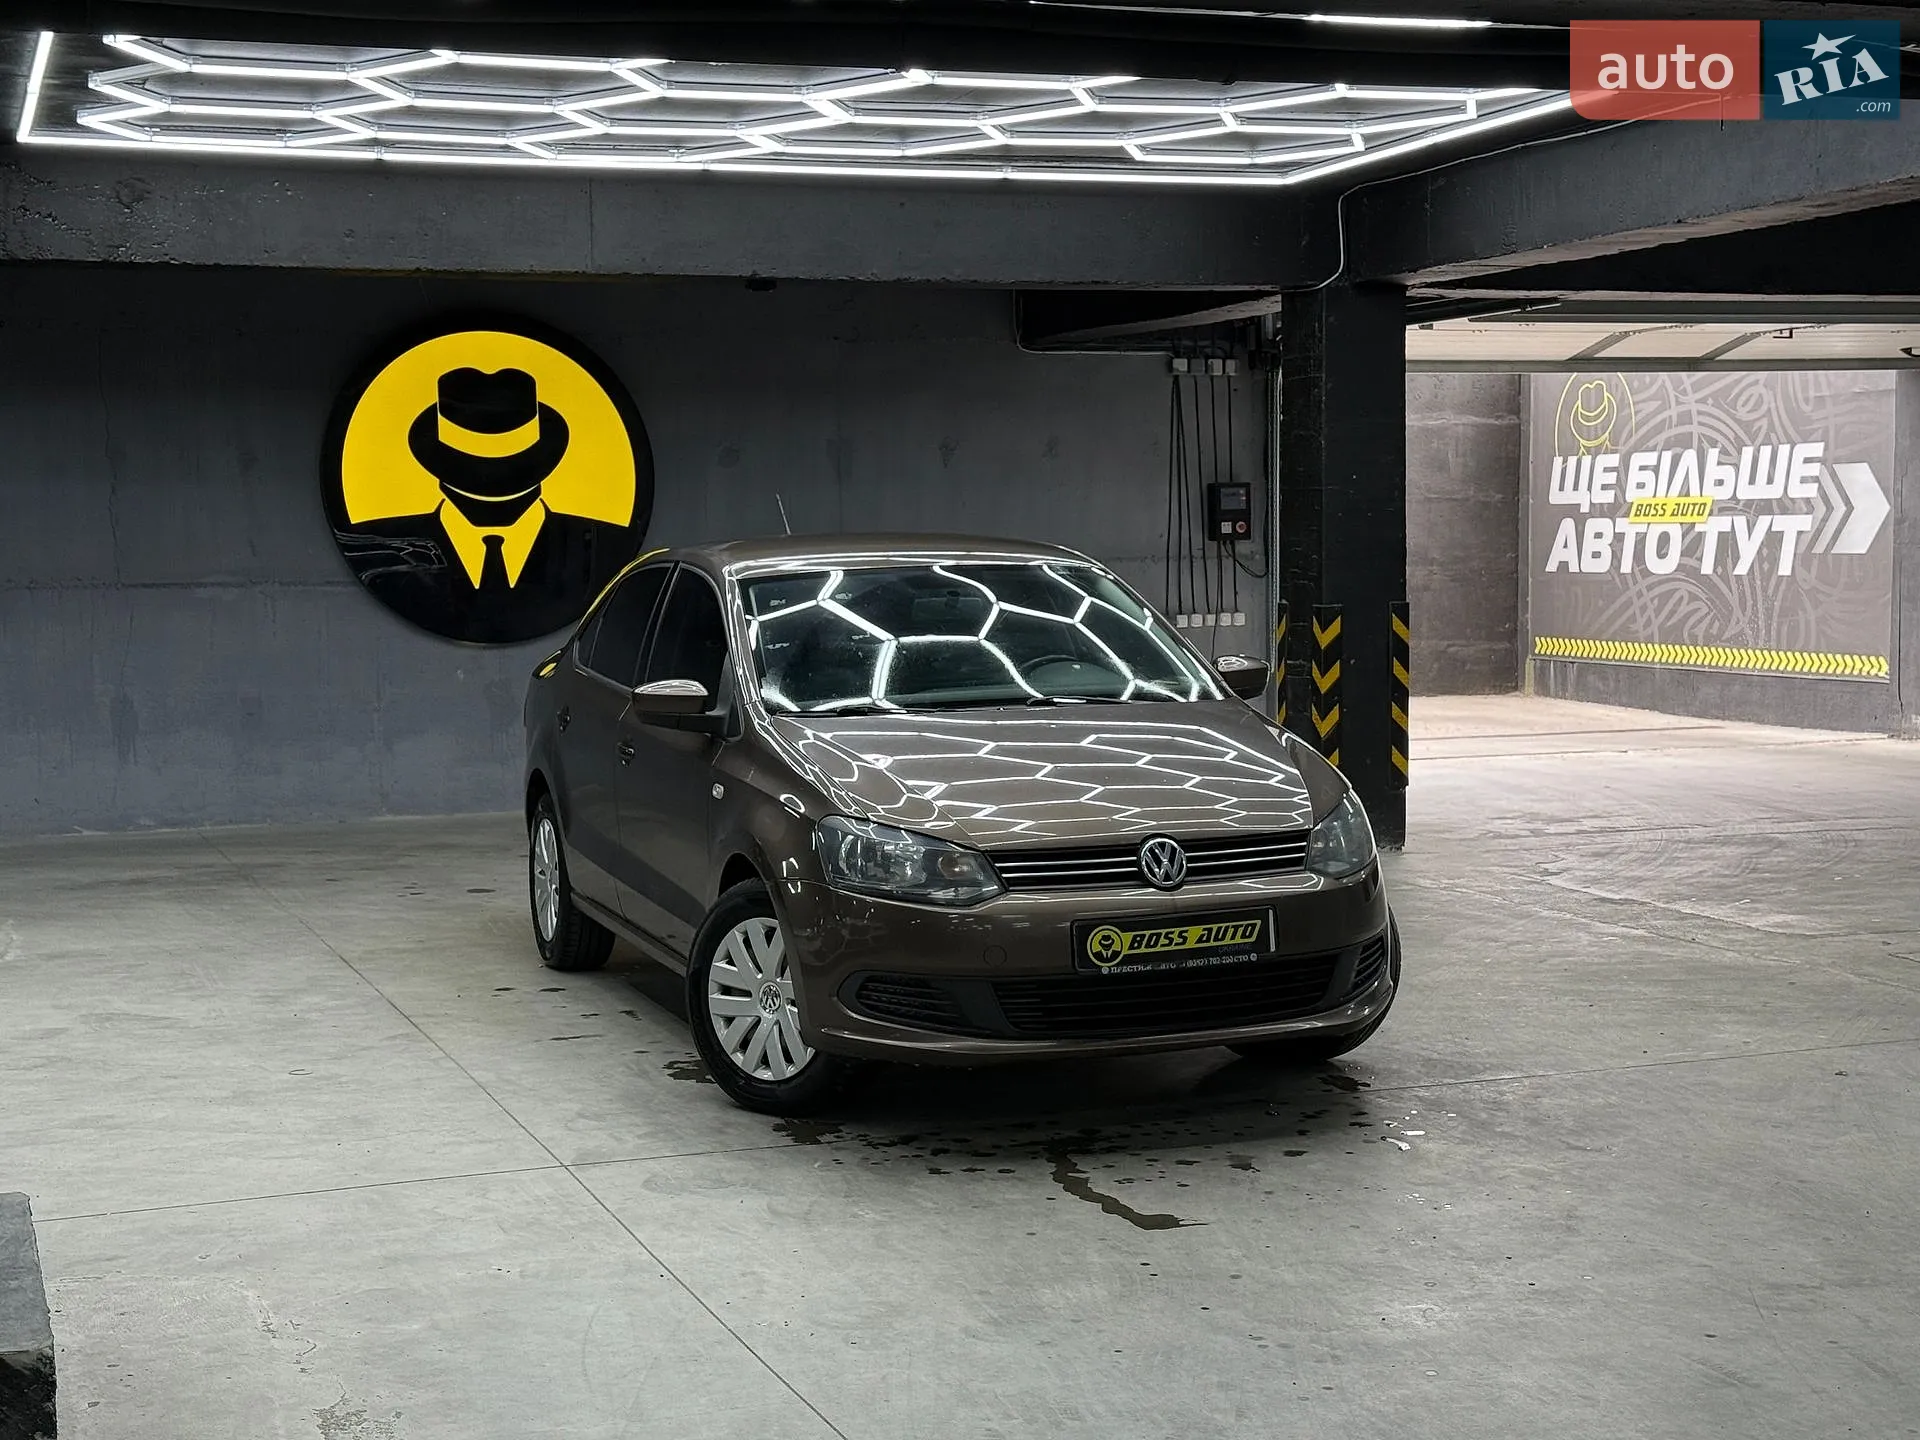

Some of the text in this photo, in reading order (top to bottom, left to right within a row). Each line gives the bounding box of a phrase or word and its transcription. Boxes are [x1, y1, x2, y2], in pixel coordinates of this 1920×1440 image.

[1549, 441, 1825, 513] ЩЕ БІЛЬШЕ
[1634, 502, 1708, 517] BOSS AUTO
[1544, 514, 1813, 576] АВТО ТУТ
[1127, 922, 1258, 951] BOSS AUTO
